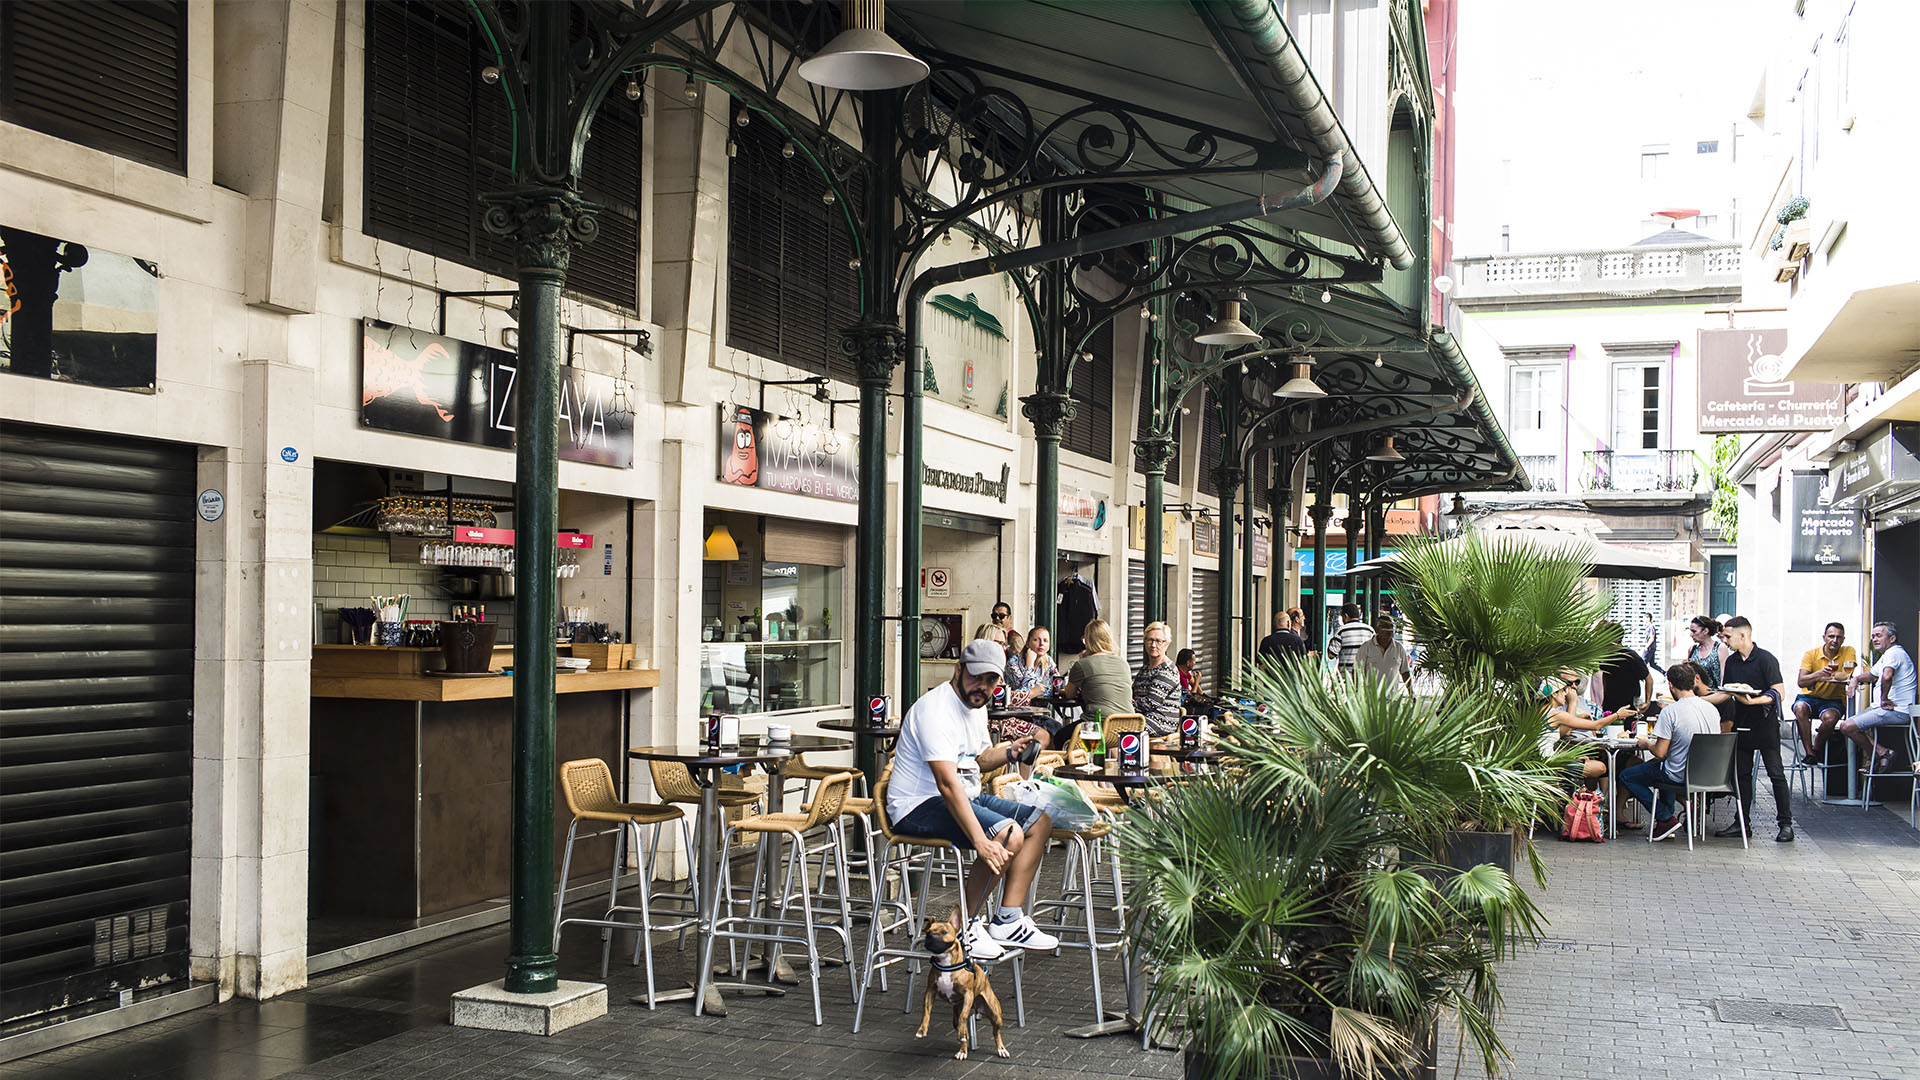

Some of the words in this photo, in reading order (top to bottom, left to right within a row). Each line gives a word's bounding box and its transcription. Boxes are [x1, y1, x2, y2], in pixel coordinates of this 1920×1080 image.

[489, 361, 608, 448] IZAYA
[1706, 399, 1766, 412] Cafetería
[1777, 398, 1838, 411] Churrería
[1701, 413, 1766, 427] Mercado
[1767, 413, 1789, 427] del
[1793, 413, 1845, 427] Puerto
[766, 471, 777, 487] TU
[814, 480, 824, 495] EN
[825, 482, 834, 497] EL
[1801, 516, 1855, 528] Mercado
[1801, 526, 1818, 536] del
[1819, 527, 1853, 536] Puerto
